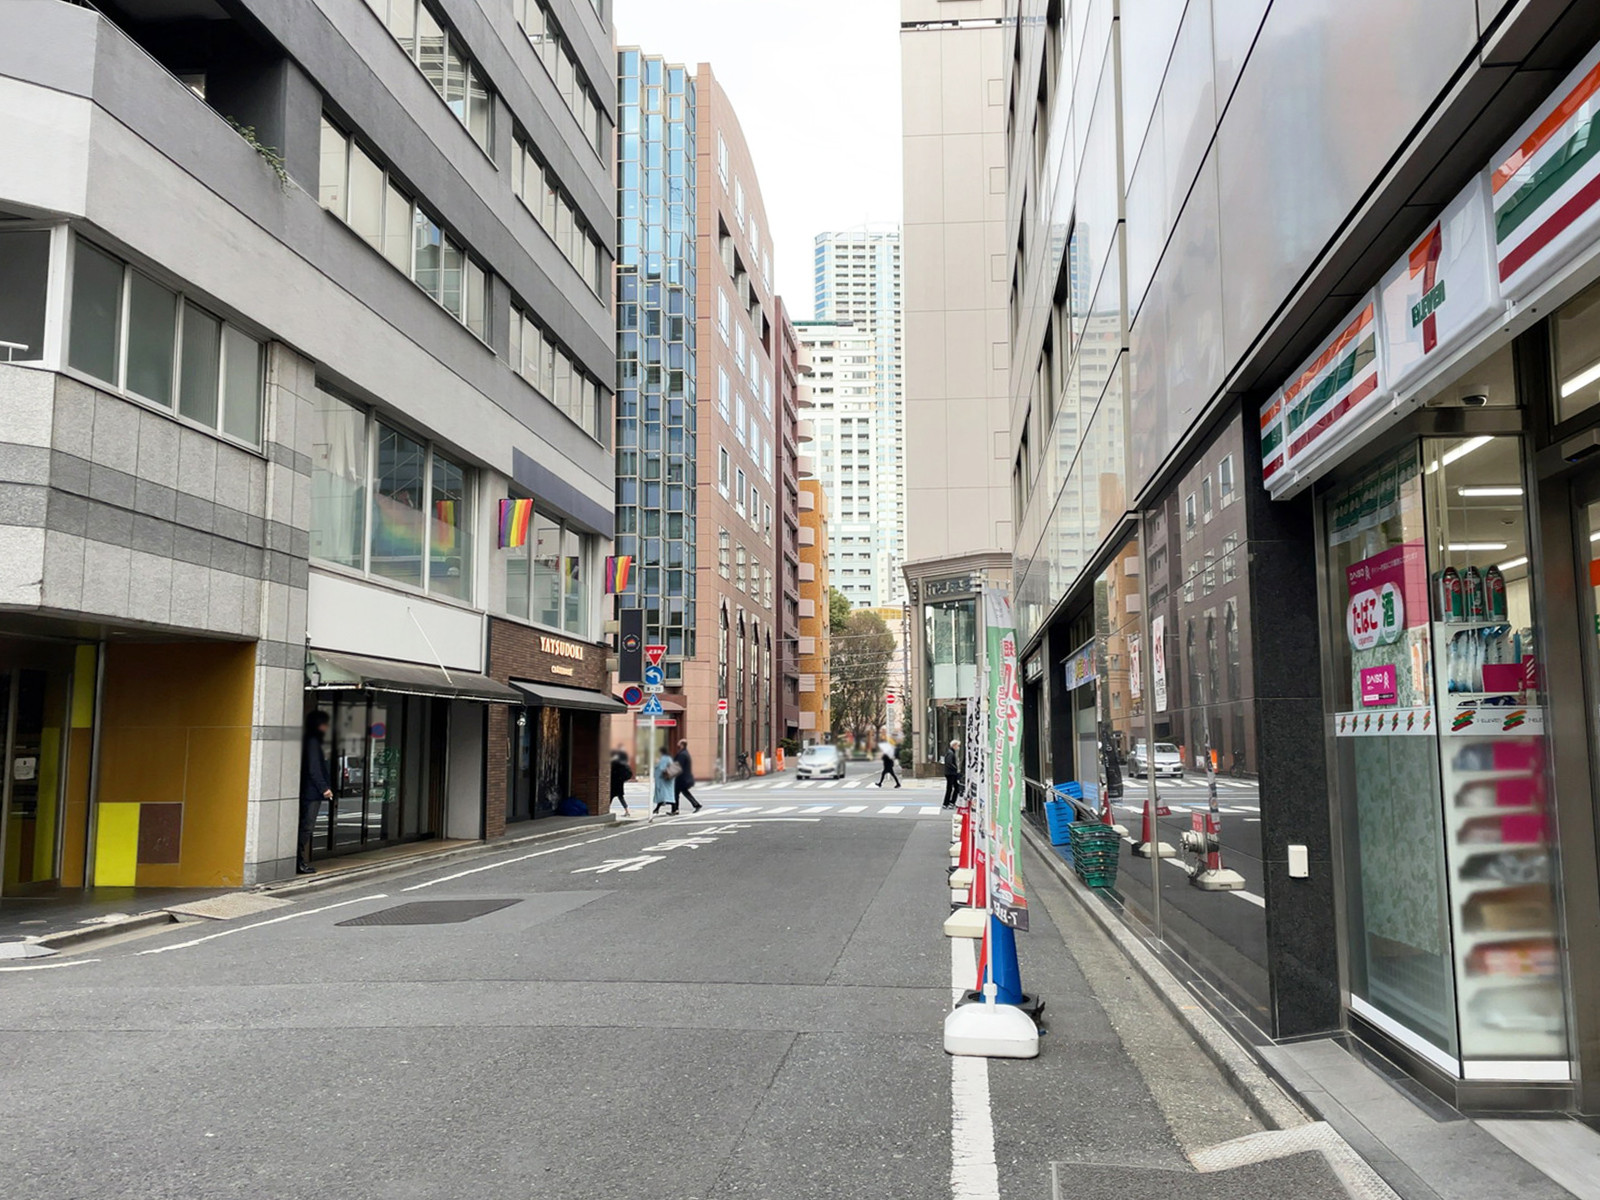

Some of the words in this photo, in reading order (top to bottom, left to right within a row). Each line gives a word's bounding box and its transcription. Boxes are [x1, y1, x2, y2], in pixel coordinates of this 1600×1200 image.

[1408, 219, 1443, 355] 7
[1411, 279, 1446, 328] ELEVEN
[1349, 568, 1365, 581] DAISO
[1352, 598, 1378, 636] たばこ
[1381, 591, 1395, 628] 酒
[540, 636, 584, 661] YATSUDOKI
[1366, 673, 1383, 685] DAISO
[570, 823, 752, 875] 止まれ
